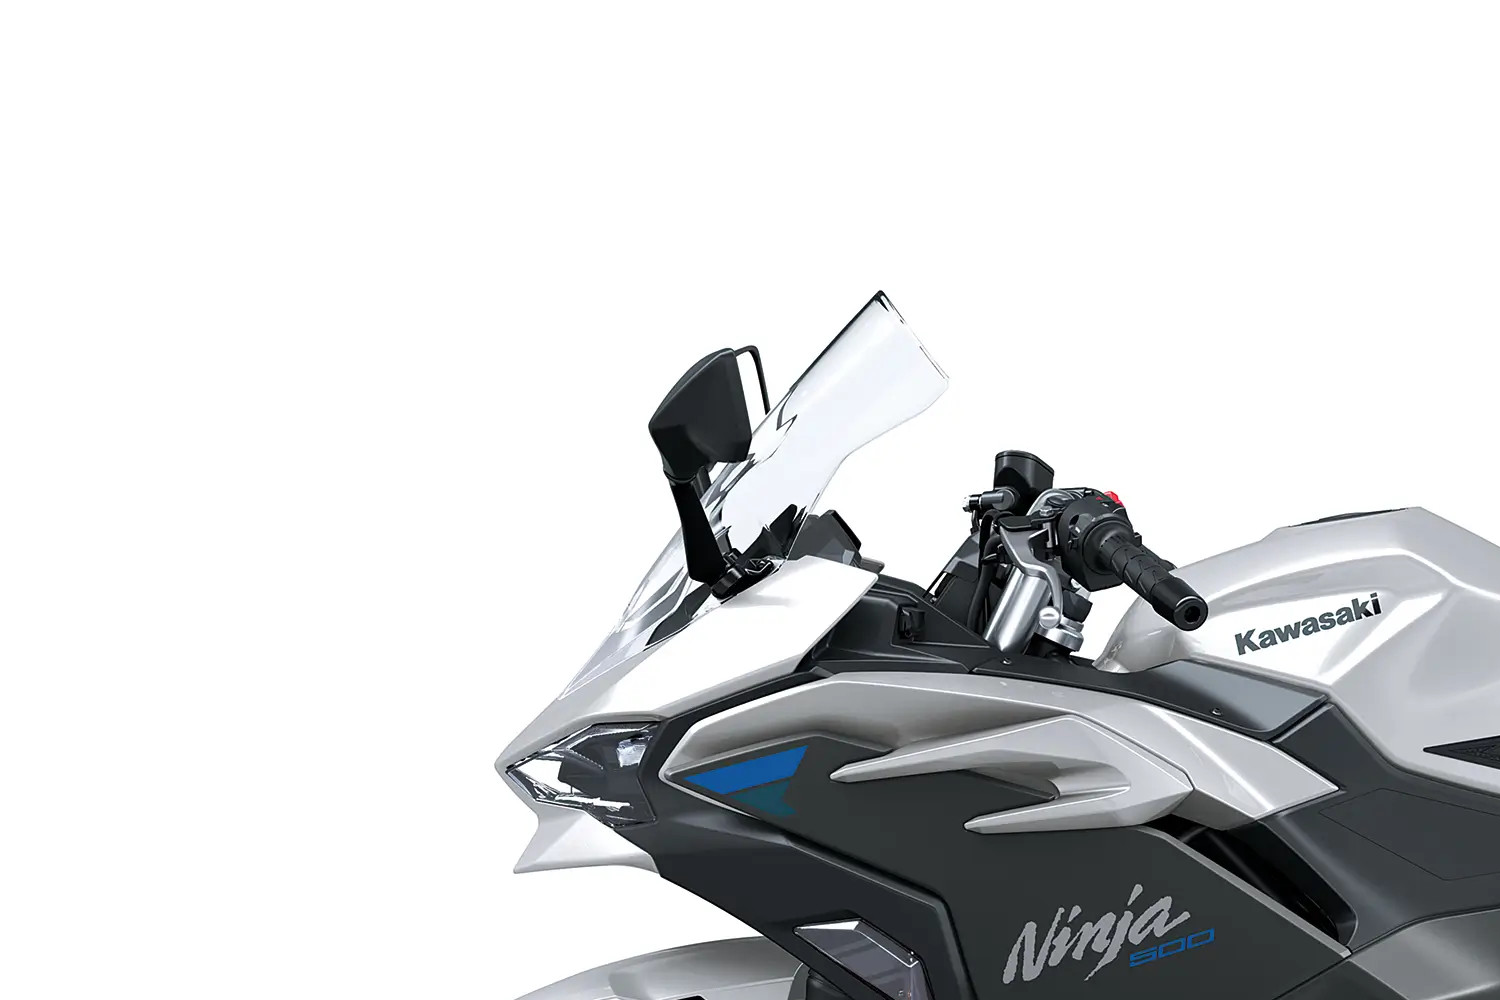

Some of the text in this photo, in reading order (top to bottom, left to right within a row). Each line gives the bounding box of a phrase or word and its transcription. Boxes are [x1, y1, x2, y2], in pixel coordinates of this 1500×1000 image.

[1234, 592, 1382, 656] Kawasaki
[1002, 883, 1215, 984] Ninja 500
